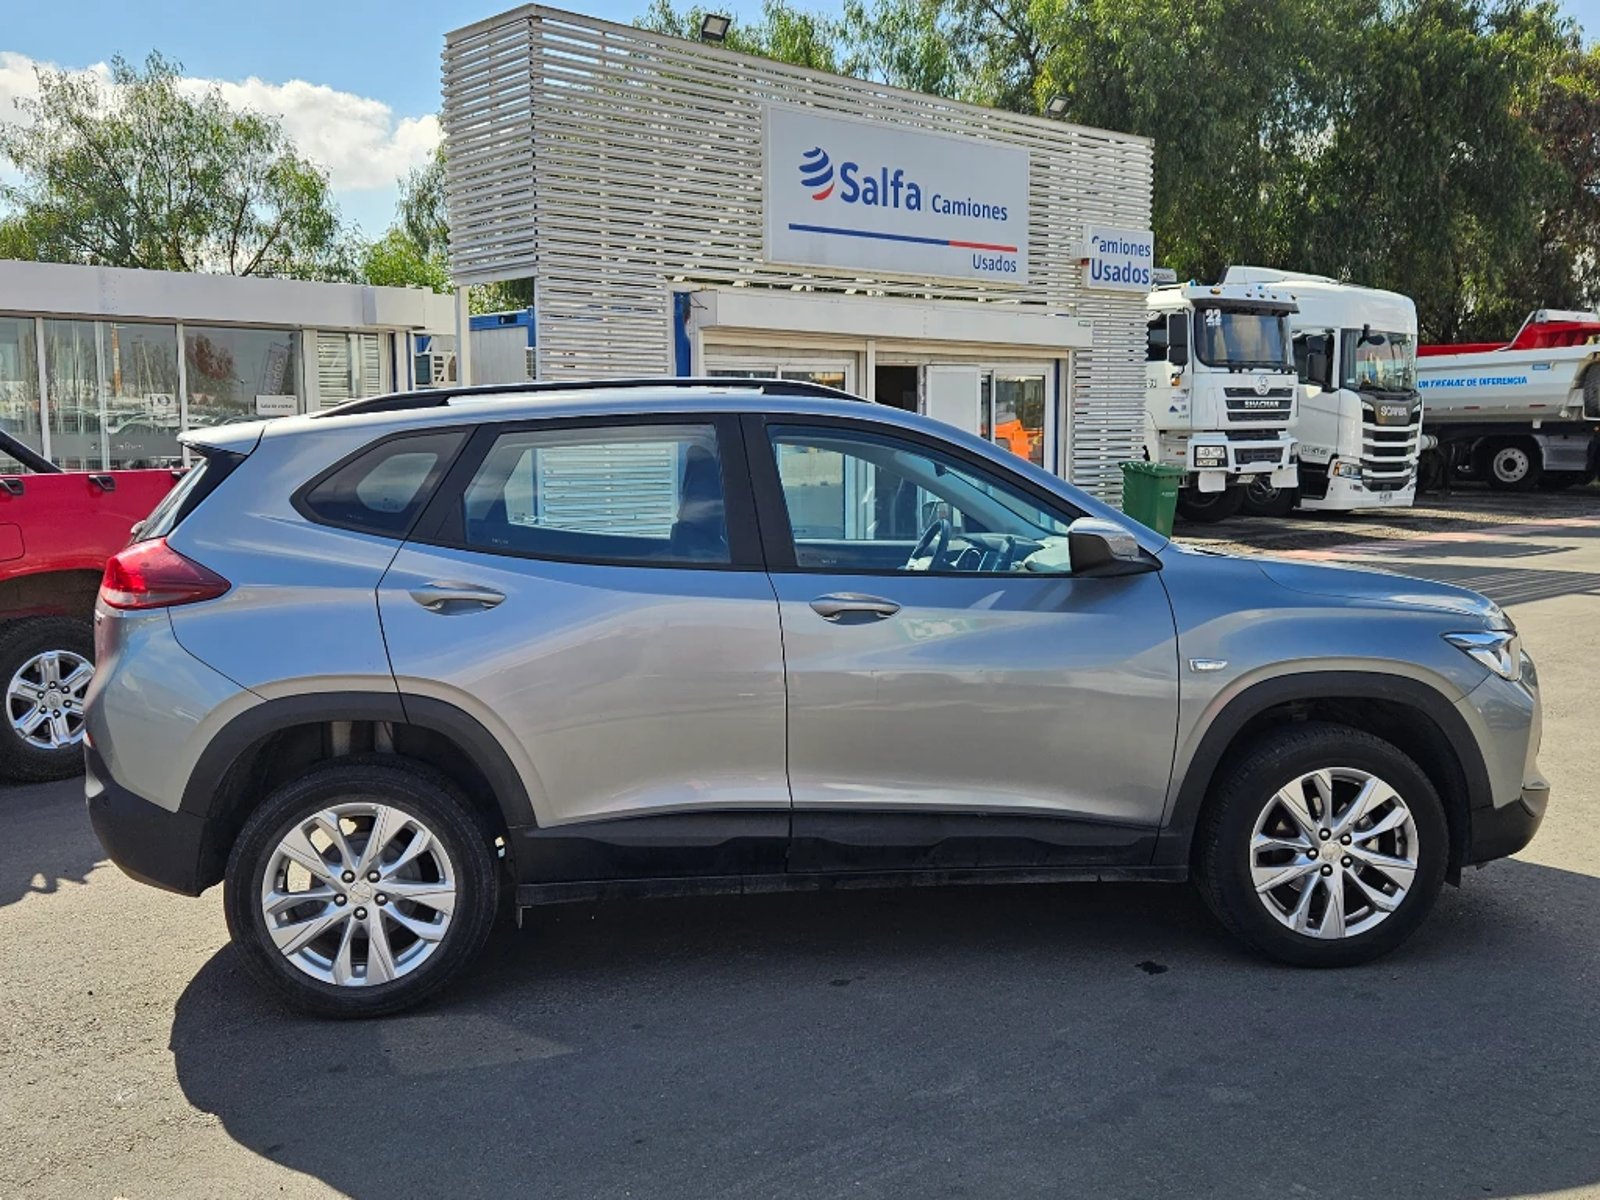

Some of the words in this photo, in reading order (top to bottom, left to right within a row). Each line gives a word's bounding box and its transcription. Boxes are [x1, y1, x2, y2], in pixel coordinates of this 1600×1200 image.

[840, 161, 921, 211] Salfa
[932, 194, 1008, 221] Camiones
[972, 253, 1017, 273] Usados
[1091, 257, 1149, 285] Usados
[1466, 378, 1477, 387] DE
[1479, 376, 1528, 386] DIFERENCIA
[1380, 405, 1408, 417] SCANIA
